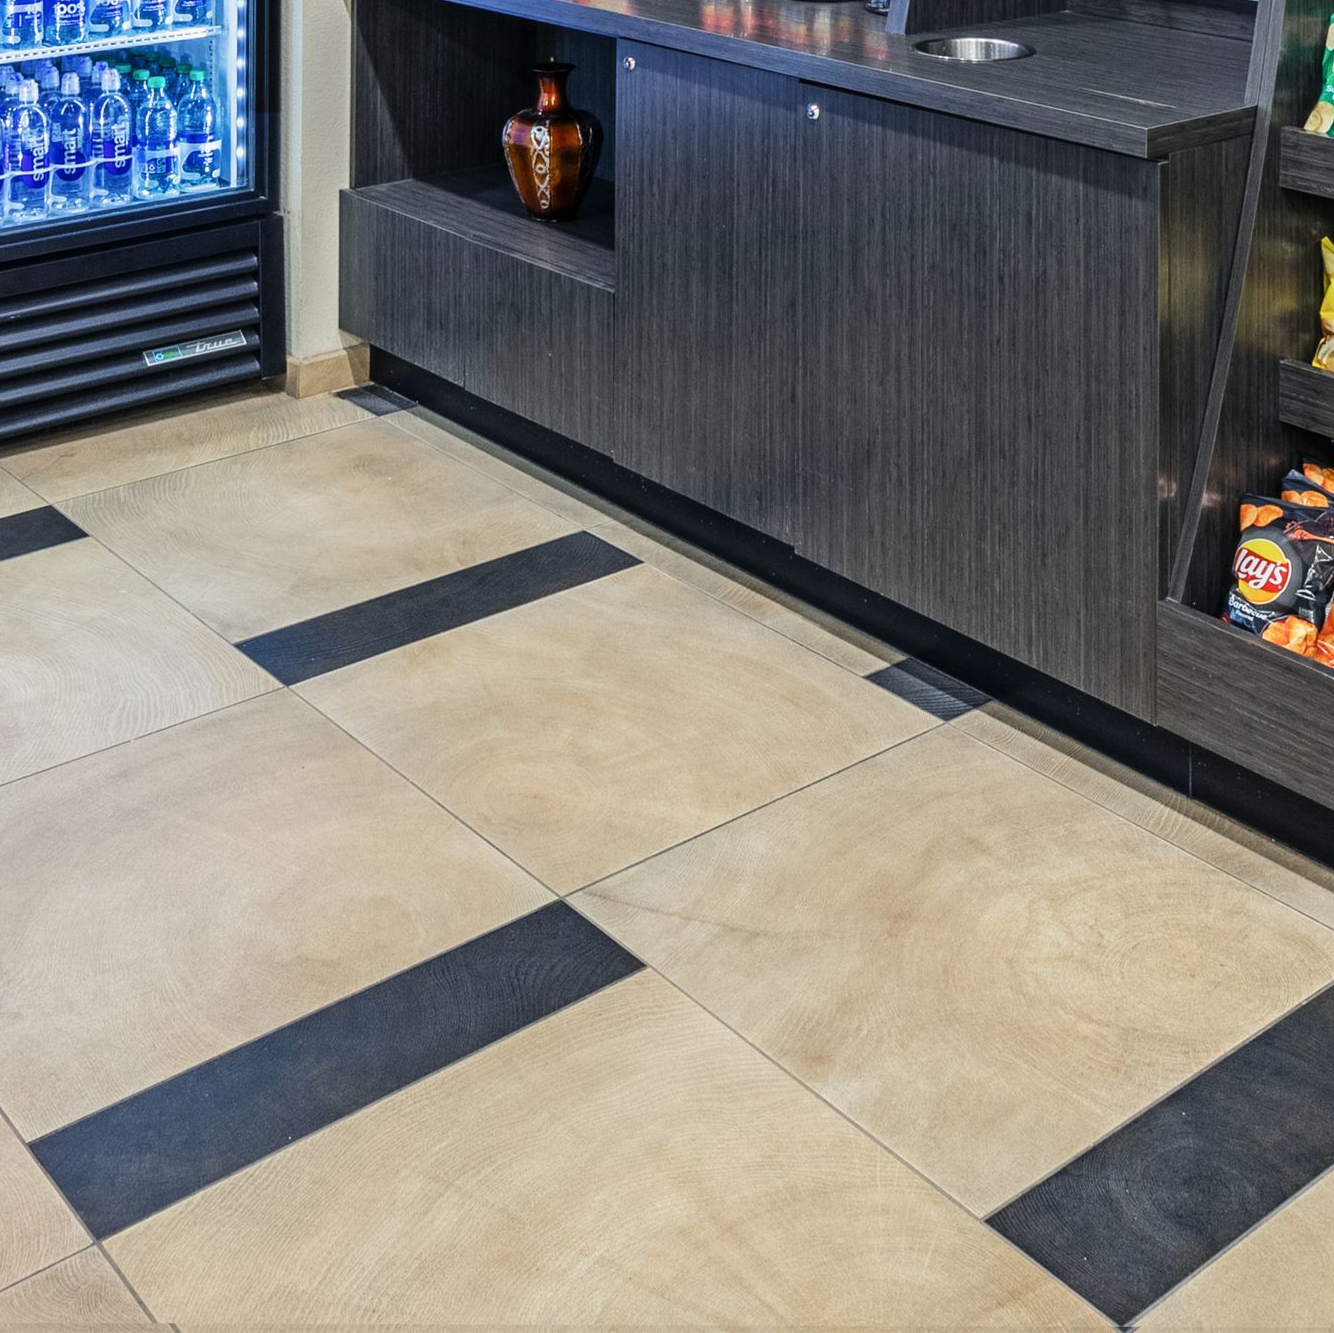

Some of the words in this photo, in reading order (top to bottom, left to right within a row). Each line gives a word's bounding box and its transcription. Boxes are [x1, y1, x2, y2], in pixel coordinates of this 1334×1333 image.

[32, 134, 45, 181] smart
[63, 128, 77, 174] smart
[114, 123, 127, 168] smart
[1233, 549, 1292, 592] Lay's
[1228, 598, 1270, 622] Barbecue
